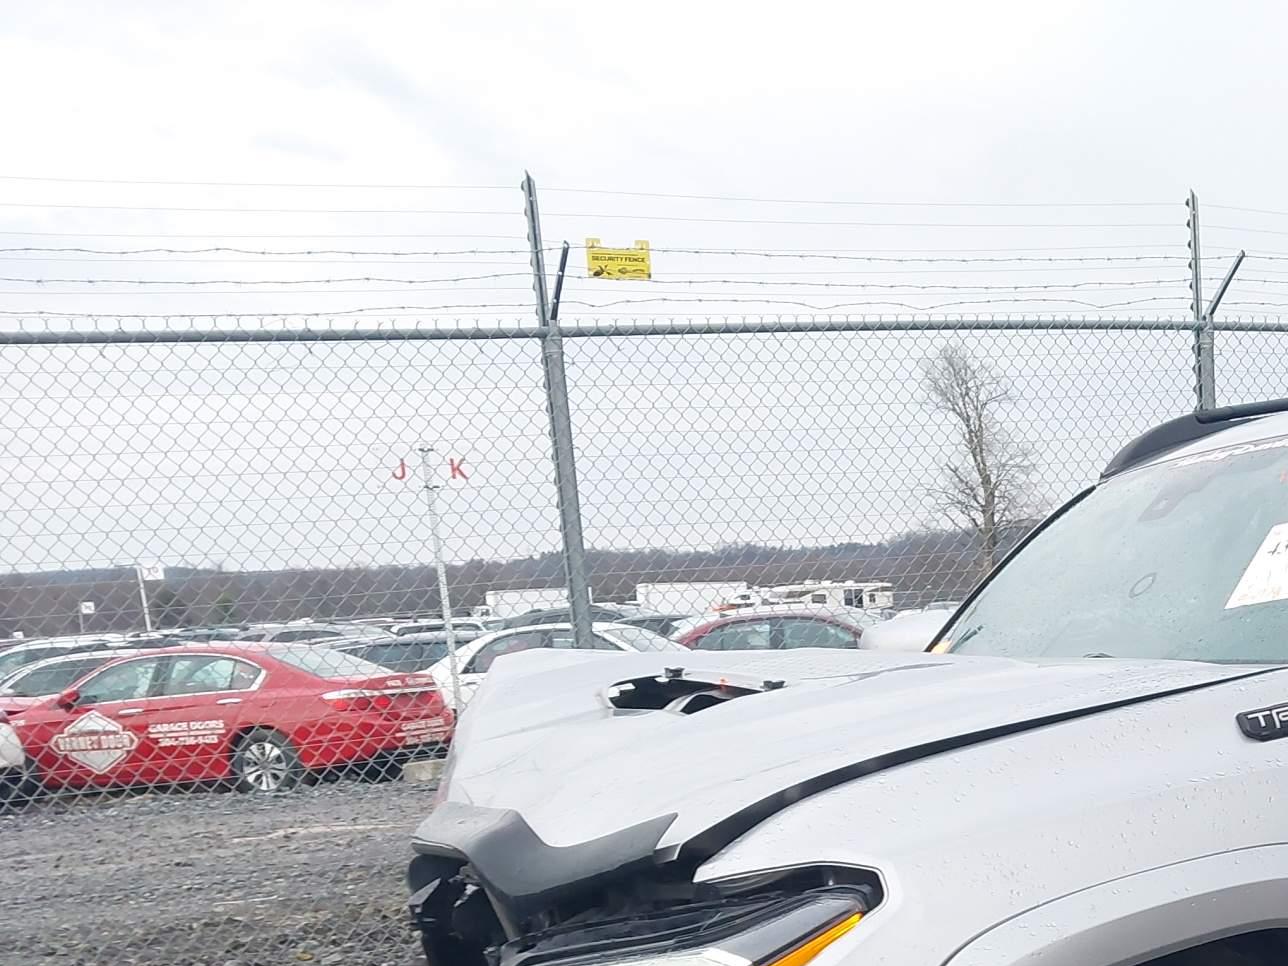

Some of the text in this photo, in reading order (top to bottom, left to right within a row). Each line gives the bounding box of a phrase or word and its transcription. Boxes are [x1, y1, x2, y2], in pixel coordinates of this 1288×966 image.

[392, 458, 406, 481] J
[449, 458, 468, 480] K
[189, 719, 224, 730] DOORS
